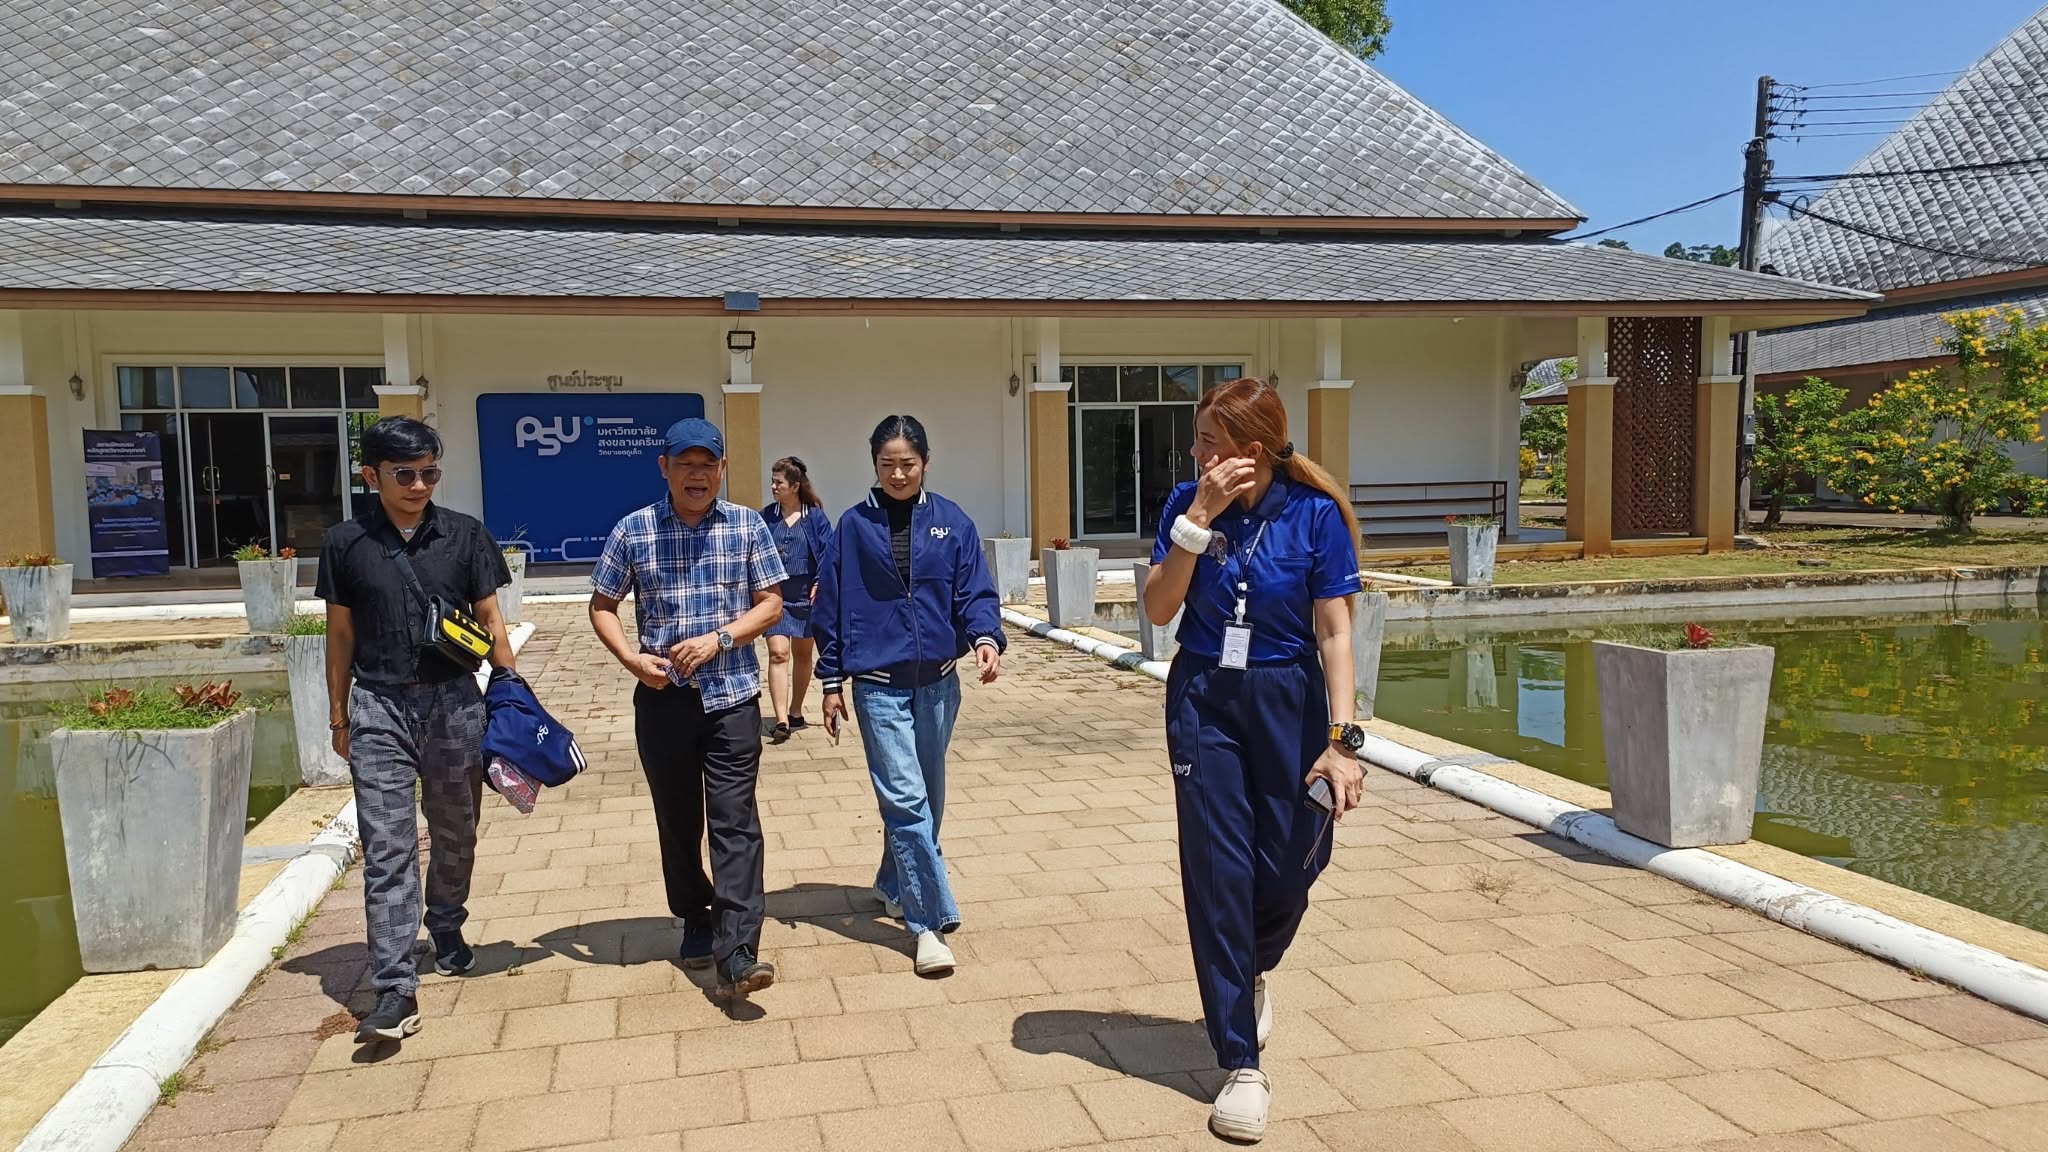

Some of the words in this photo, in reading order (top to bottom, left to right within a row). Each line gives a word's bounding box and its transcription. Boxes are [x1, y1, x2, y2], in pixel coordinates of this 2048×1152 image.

[547, 370, 623, 392] ศูนย์ประชุม
[516, 416, 581, 456] PSU
[597, 426, 657, 436] มหาวิทยาลัย
[598, 437, 666, 447] สงขลานครินท
[930, 526, 949, 539] PSU
